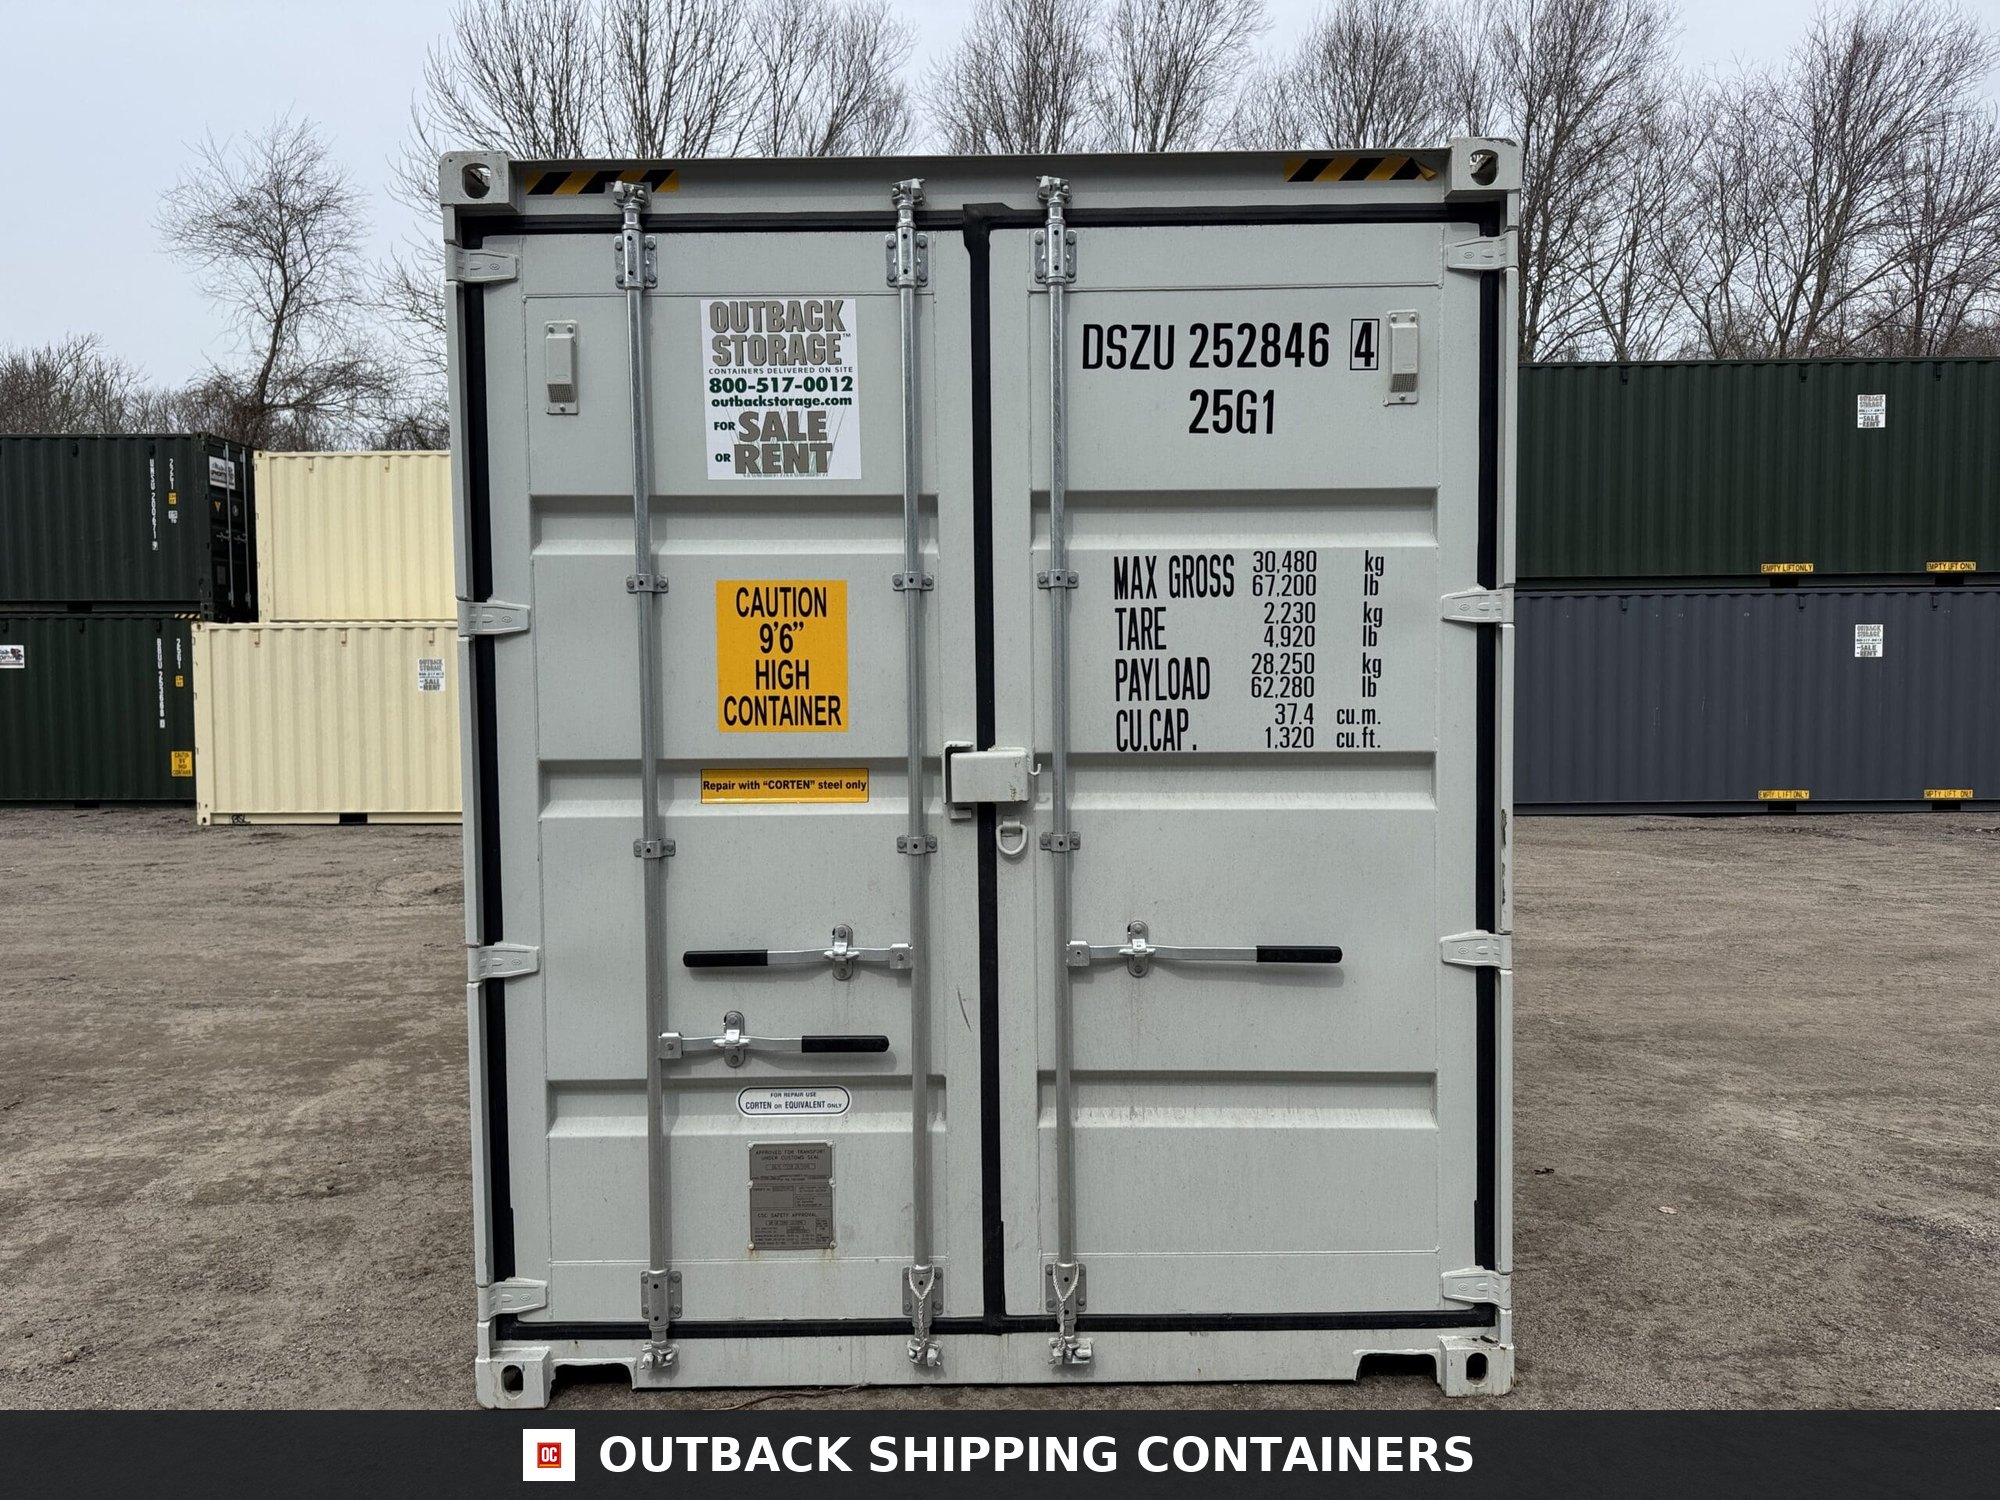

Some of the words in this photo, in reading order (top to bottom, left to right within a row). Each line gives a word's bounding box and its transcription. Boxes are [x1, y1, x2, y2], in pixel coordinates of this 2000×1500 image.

[709, 300, 846, 333] OUTBACK
[711, 333, 842, 366] STORAGE
[1082, 323, 1175, 370] DSZU
[1189, 322, 1330, 368] 252846
[1353, 322, 1375, 367] 4
[708, 367, 764, 375] CONTAINERS
[767, 366, 815, 374] DELIVERED
[818, 366, 832, 374] ON
[709, 376, 853, 394] 800-517-0012
[711, 395, 852, 408] outbackstorage.com
[1189, 389, 1275, 434] 25G1
[714, 422, 735, 431] FOR
[738, 410, 828, 442] SALE
[715, 453, 731, 462] OR
[734, 443, 832, 475] RENT
[1113, 555, 1157, 600] MAX
[1169, 554, 1235, 599] GROSS
[1252, 550, 1317, 575] 30,480
[1365, 550, 1385, 576] kg
[1252, 574, 1317, 597] 67,200
[1363, 574, 1379, 596] lb
[736, 586, 827, 618] CAUTION
[1264, 601, 1316, 625] 2,230
[1363, 601, 1383, 628] kg
[1115, 606, 1167, 651] TARE
[1263, 625, 1316, 649] 4,920
[1362, 625, 1377, 647] lb
[755, 659, 809, 690] HIGH
[1115, 656, 1211, 702] PAYLOAD
[1251, 652, 1315, 676] 28,250
[1362, 652, 1382, 678] kg
[1251, 676, 1315, 699] 62,280
[1361, 675, 1377, 698] lb
[724, 695, 842, 726] CONTAINER
[1274, 703, 1314, 725] 37.4
[1336, 707, 1381, 725] cu.m.
[1116, 708, 1197, 752] CU.CAP.
[1265, 726, 1314, 749] 1,320
[1336, 726, 1381, 748] cu.ft.
[703, 781, 735, 792] Repair
[739, 780, 760, 789] with
[818, 779, 842, 789] steel
[845, 780, 866, 791] only
[745, 1101, 771, 1109] CORTEN
[785, 1101, 825, 1109] EQUIVALENT
